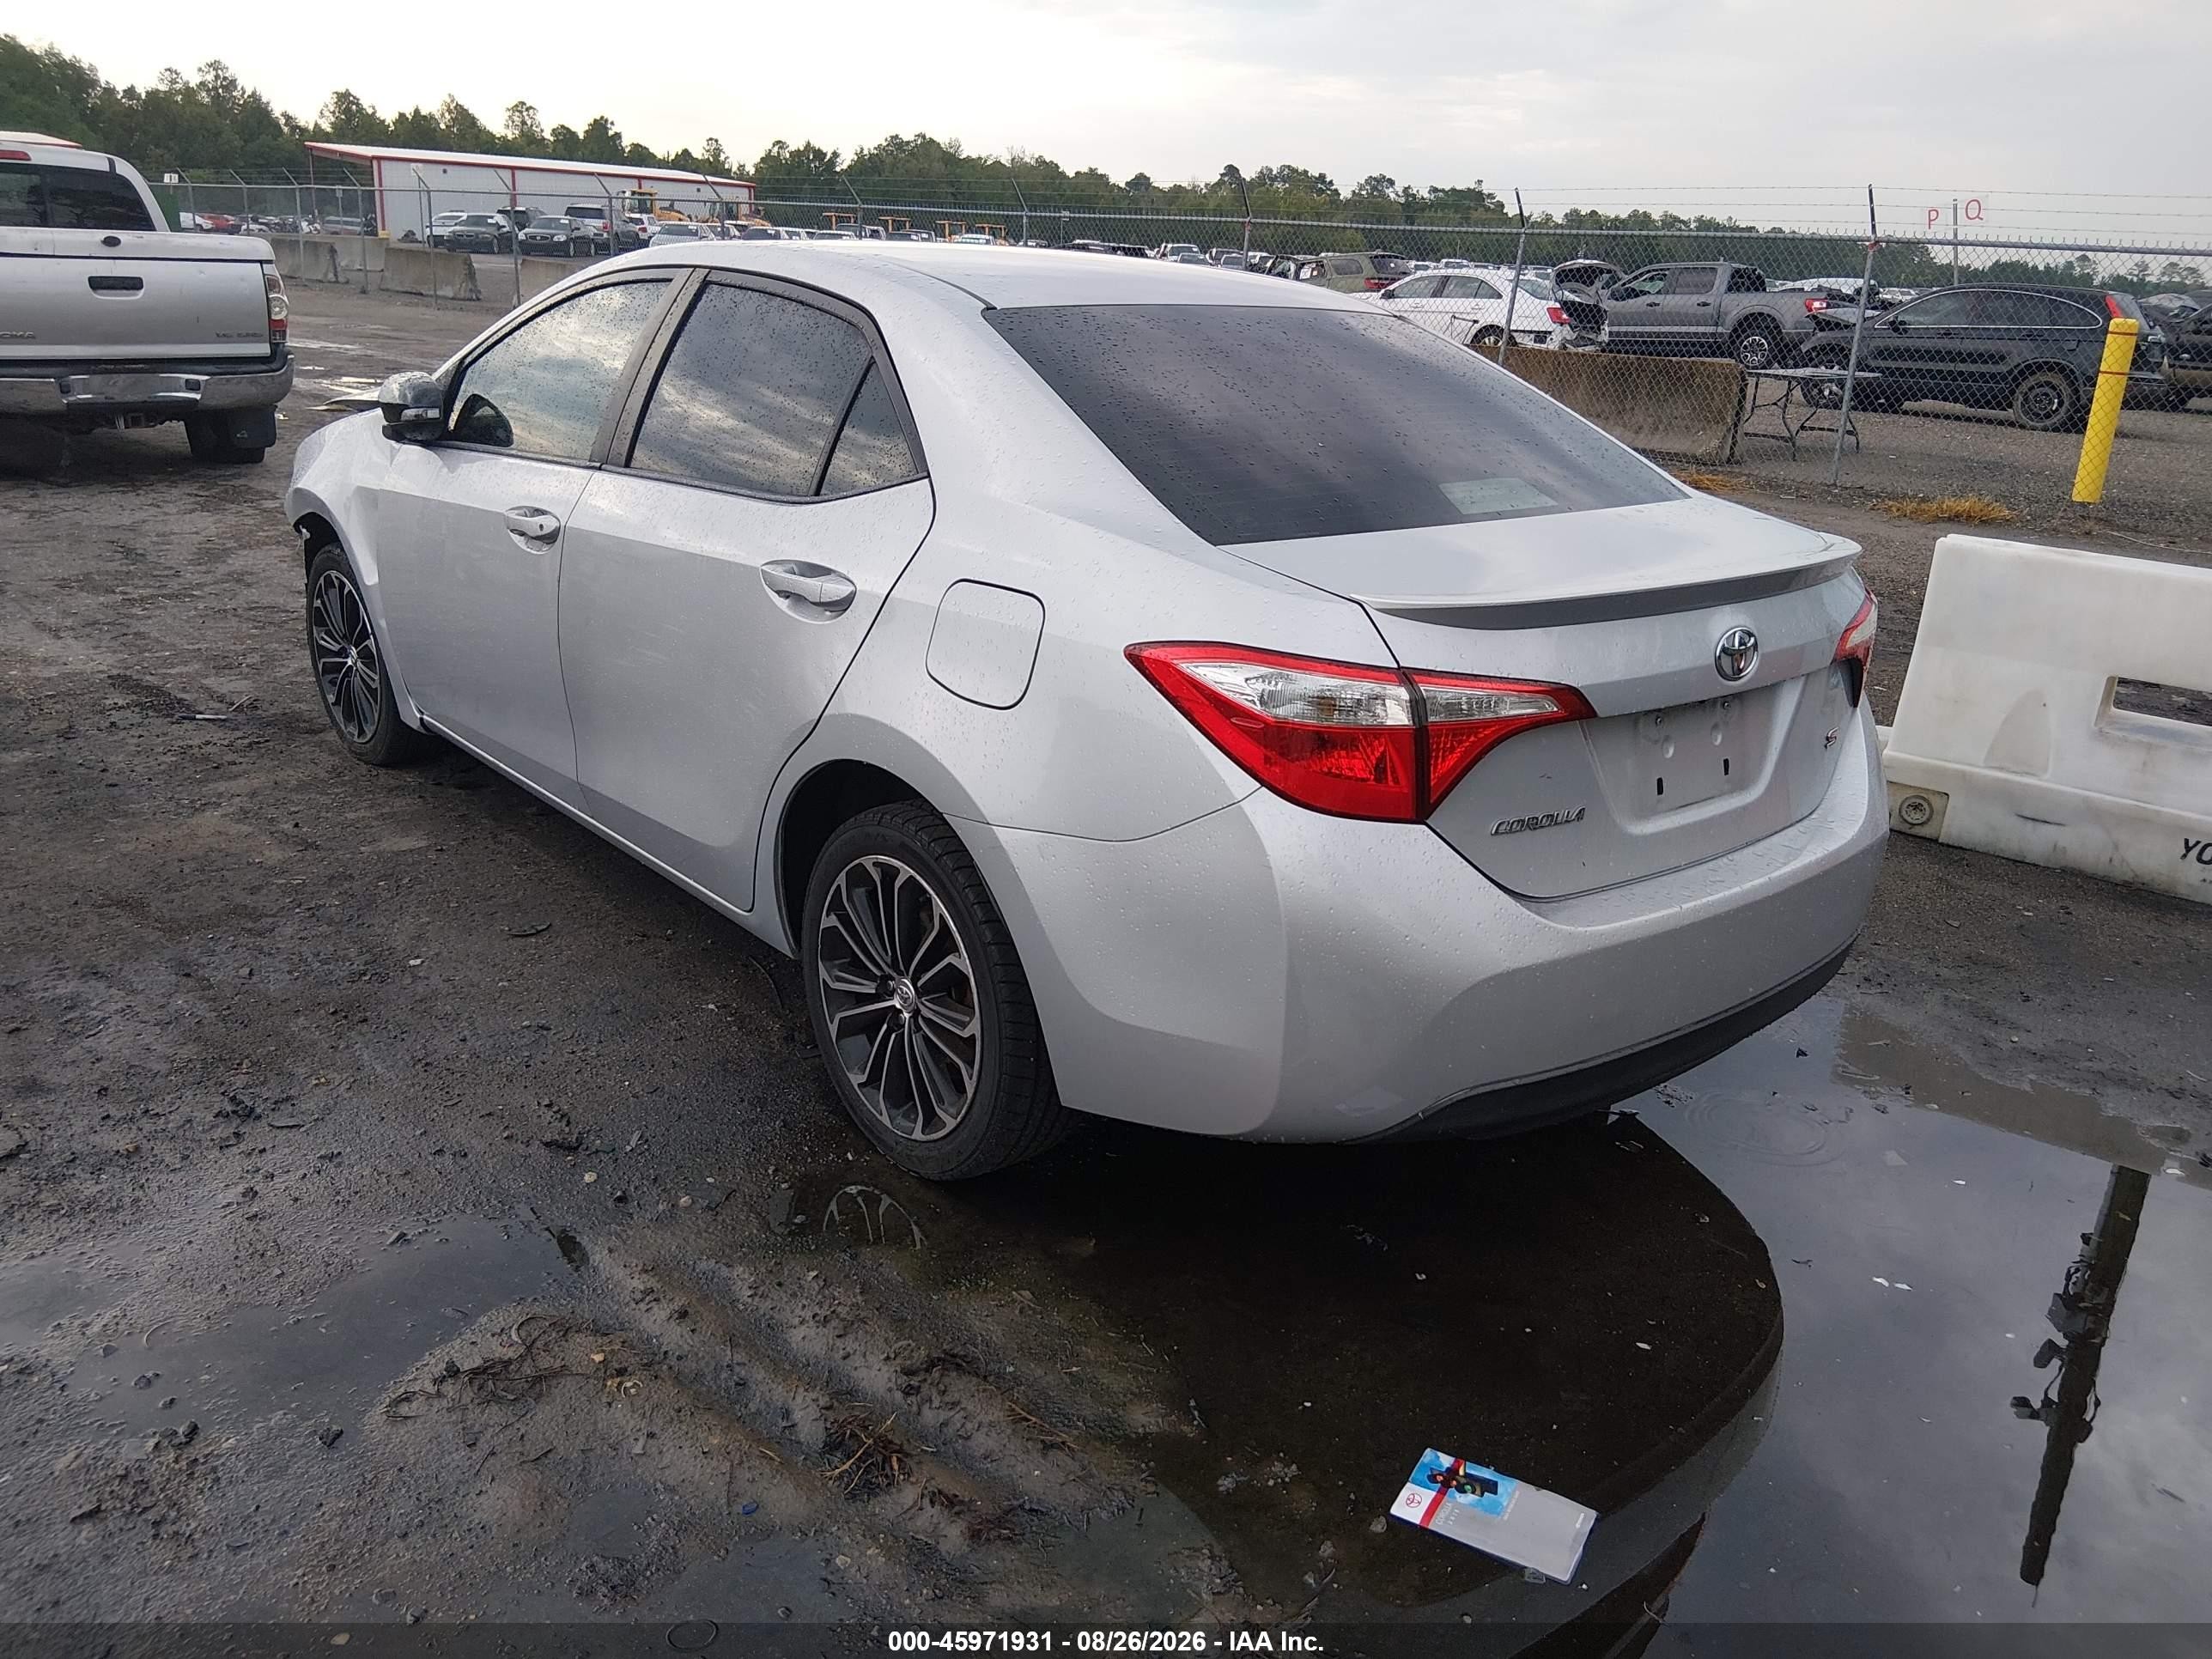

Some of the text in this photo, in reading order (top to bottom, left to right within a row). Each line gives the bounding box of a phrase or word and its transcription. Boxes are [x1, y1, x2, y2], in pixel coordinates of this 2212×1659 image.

[1928, 209, 1940, 230] P
[1965, 198, 1984, 221] Q
[1491, 805, 1586, 836] COROLLA
